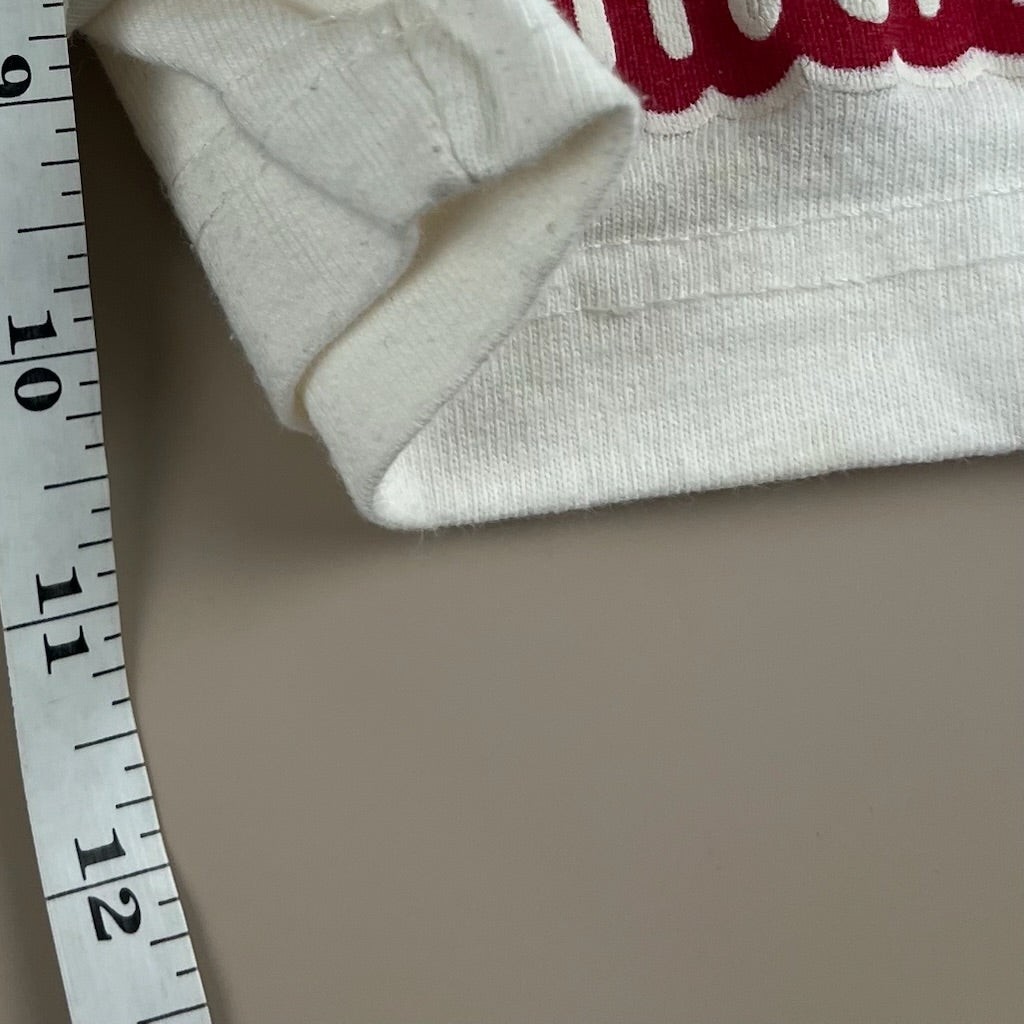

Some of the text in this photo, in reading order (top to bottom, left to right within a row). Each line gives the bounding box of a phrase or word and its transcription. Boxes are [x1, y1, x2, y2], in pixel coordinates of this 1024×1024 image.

[7, 309, 63, 412] 10
[35, 566, 90, 675] 11
[74, 827, 142, 942] 12
